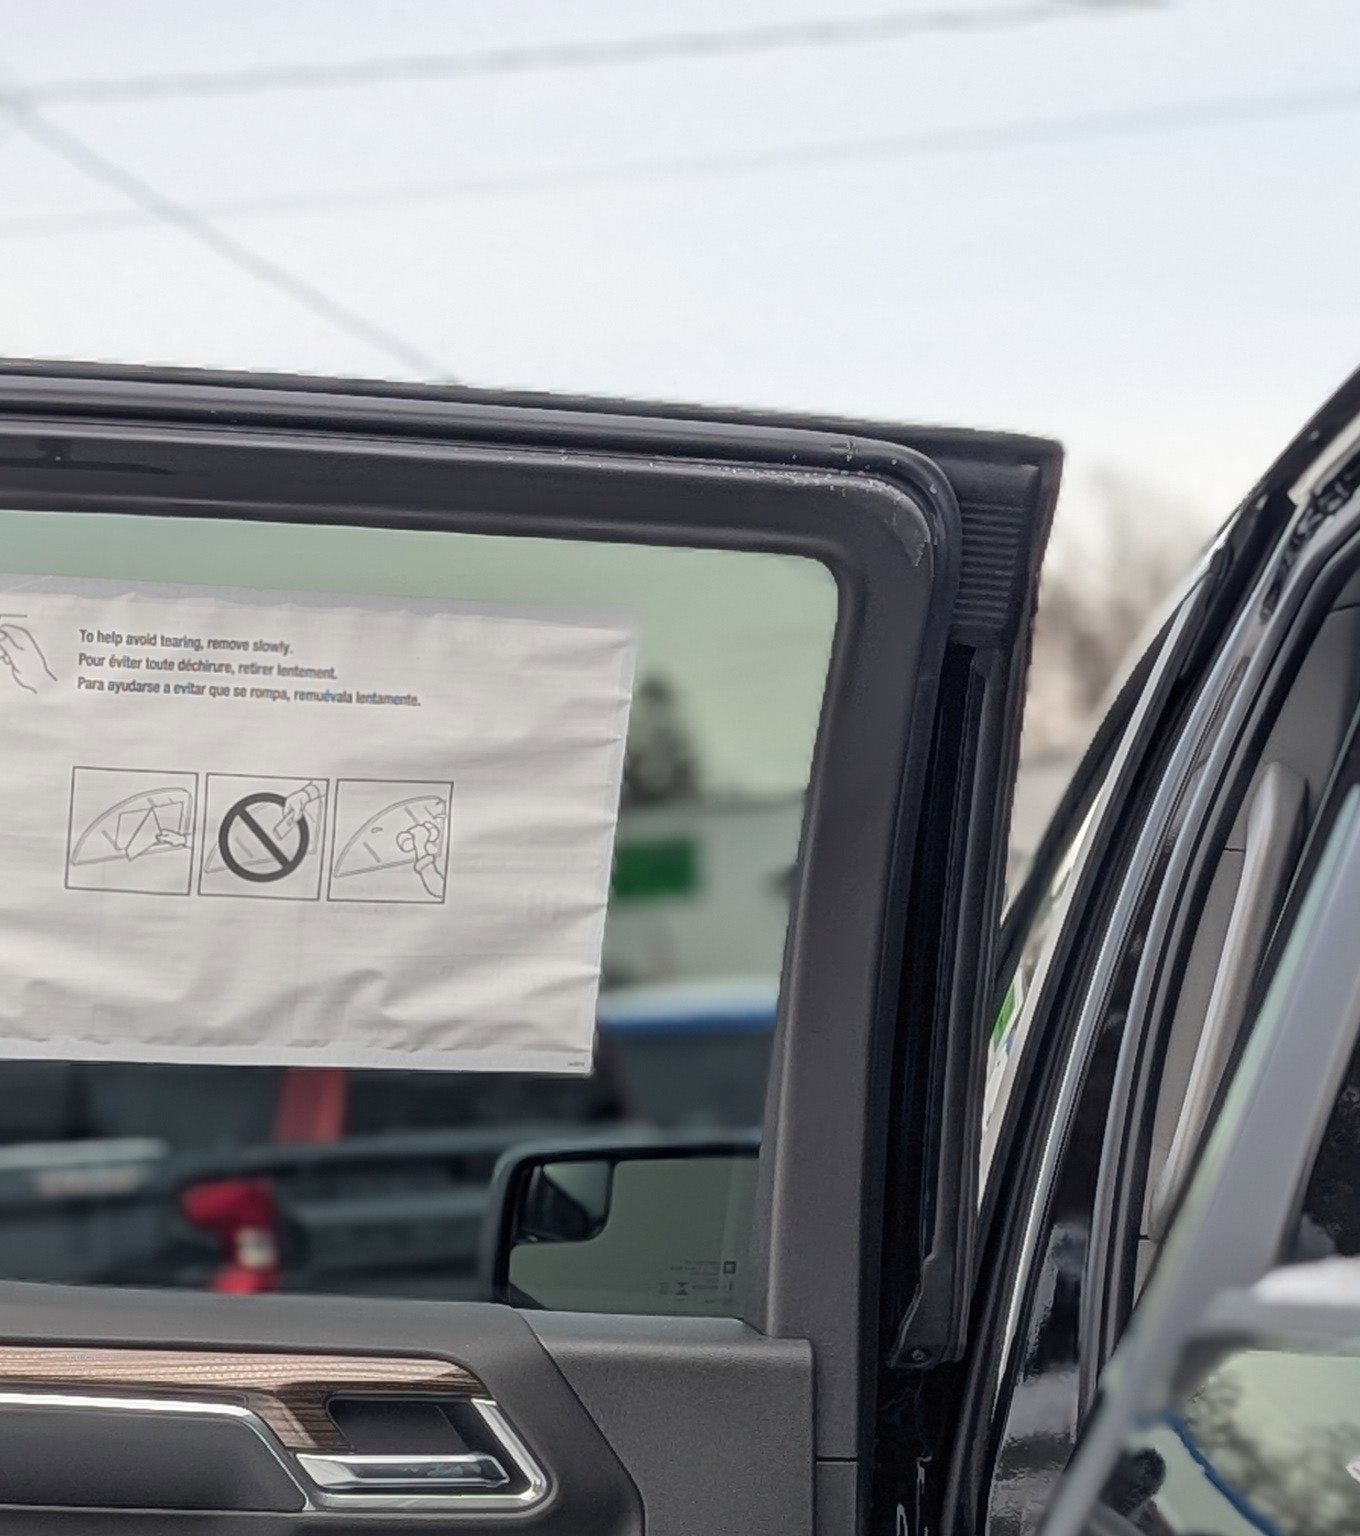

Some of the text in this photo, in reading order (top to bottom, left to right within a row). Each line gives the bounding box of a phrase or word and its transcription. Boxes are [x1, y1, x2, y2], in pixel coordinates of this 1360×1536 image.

[79, 629, 293, 656] To help avoid tearing, remove slowly.
[78, 652, 338, 680] Pour éviter toute déchirure, retirer lentement.
[77, 676, 421, 707] Para ayudarse a evitar que se rompa, remuévala lentamente.
